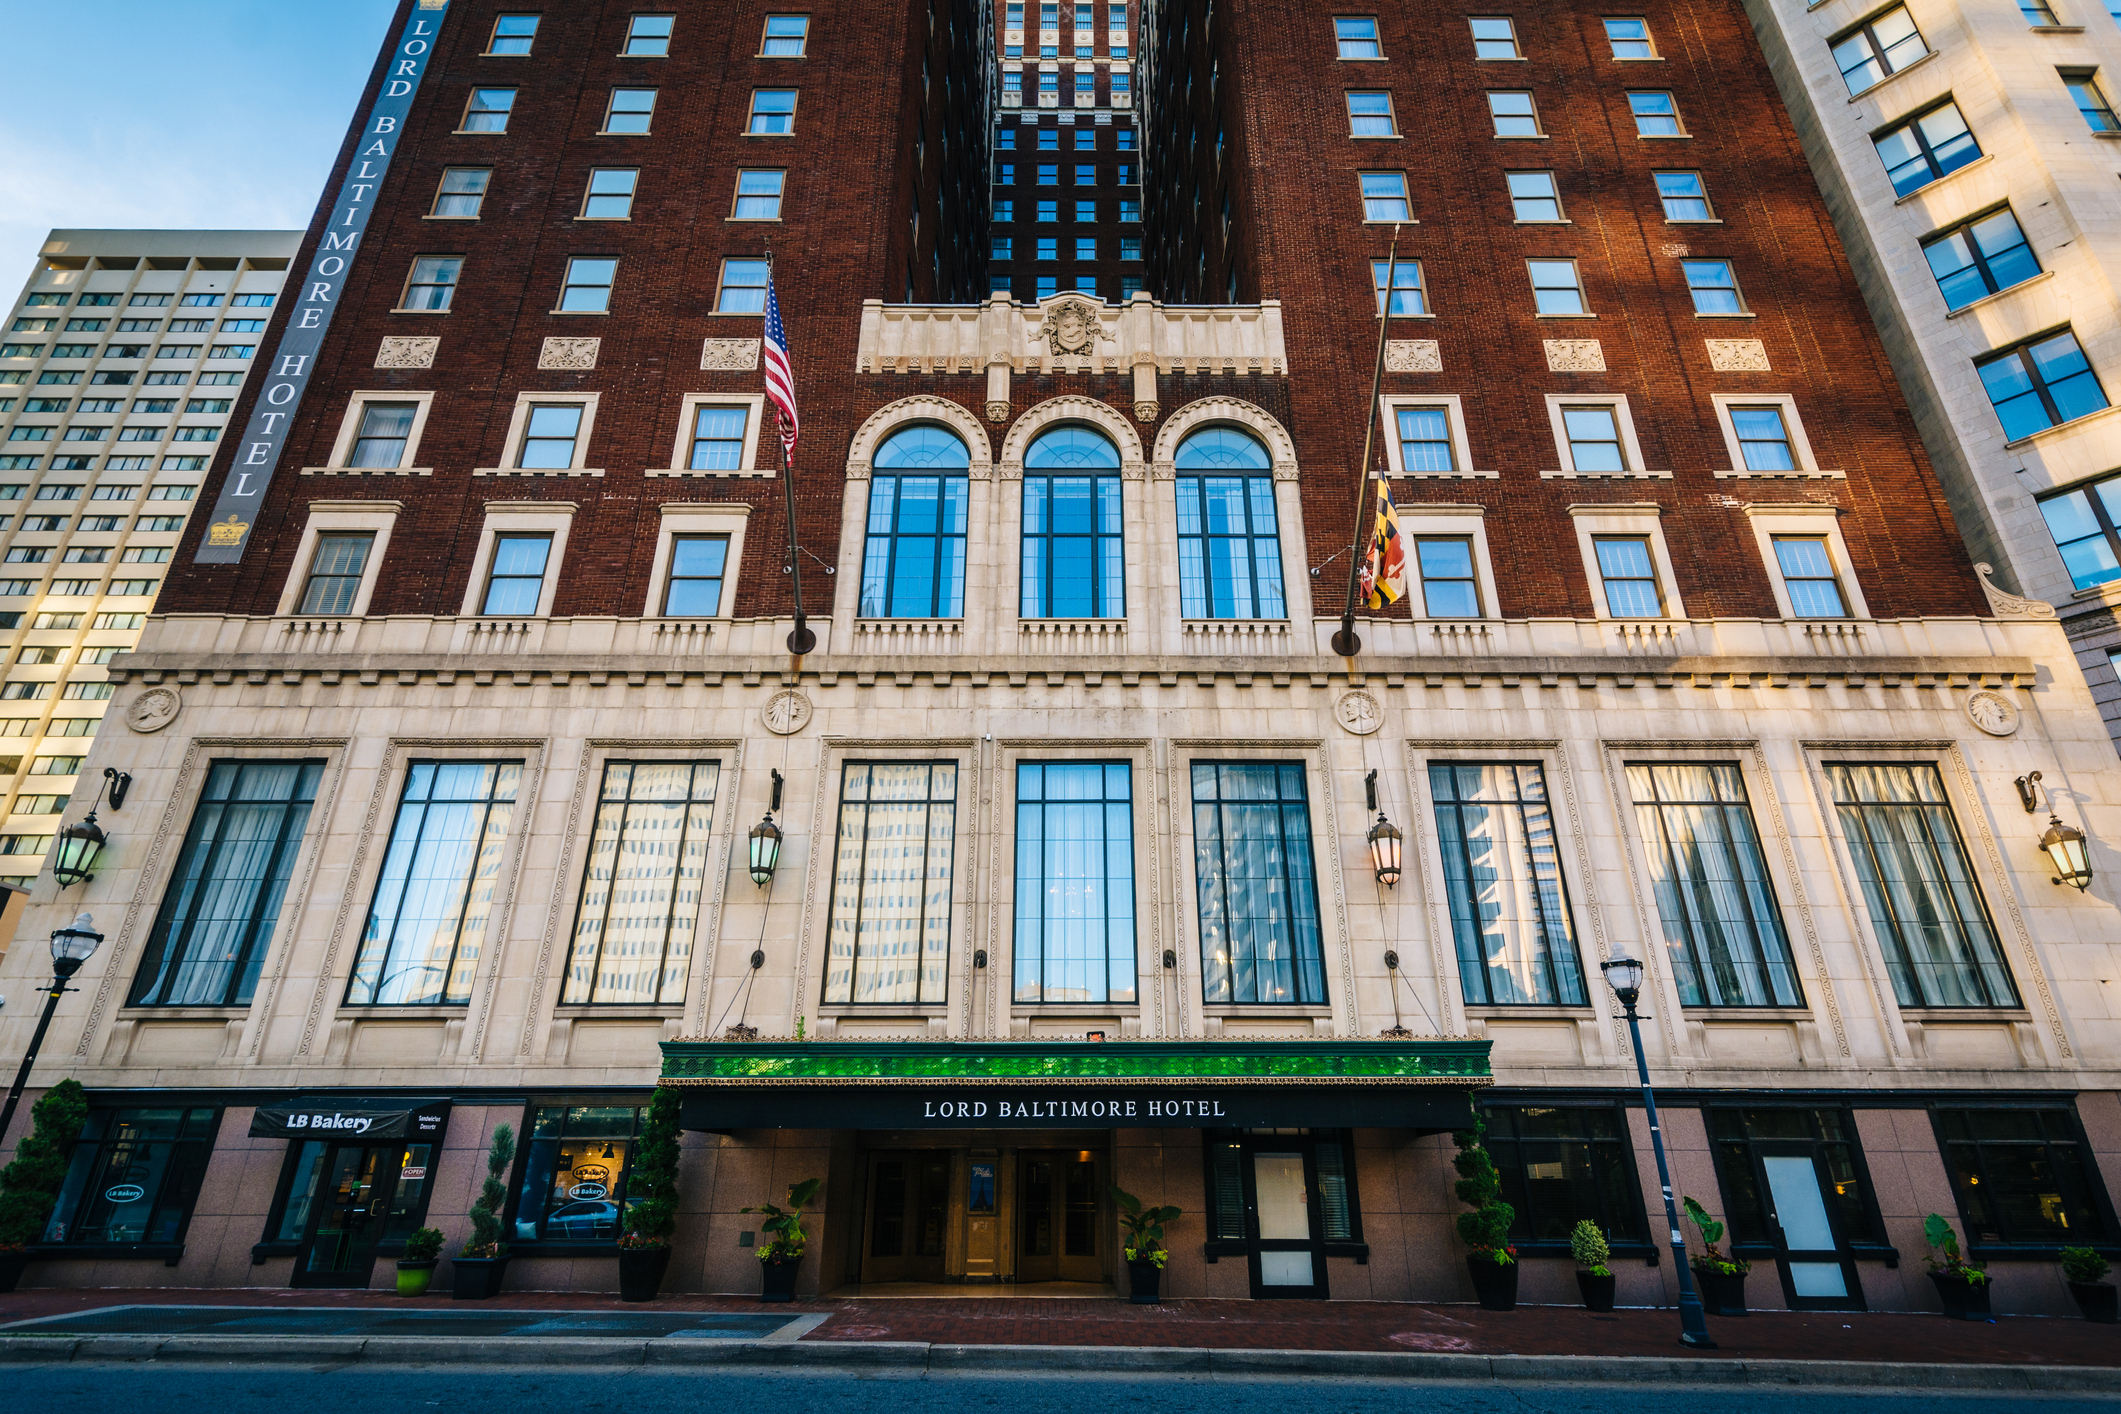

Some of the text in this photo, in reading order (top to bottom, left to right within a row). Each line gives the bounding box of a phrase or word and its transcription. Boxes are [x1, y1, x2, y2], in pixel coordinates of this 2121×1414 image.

[232, 20, 431, 497] LORD BALTIMORE HOTEL
[925, 1100, 1225, 1117] LORD BALTIMORE HOTEL
[287, 1113, 373, 1134] LB Bakery
[118, 1190, 141, 1198] Bakery
[581, 1188, 604, 1196] Bakery
